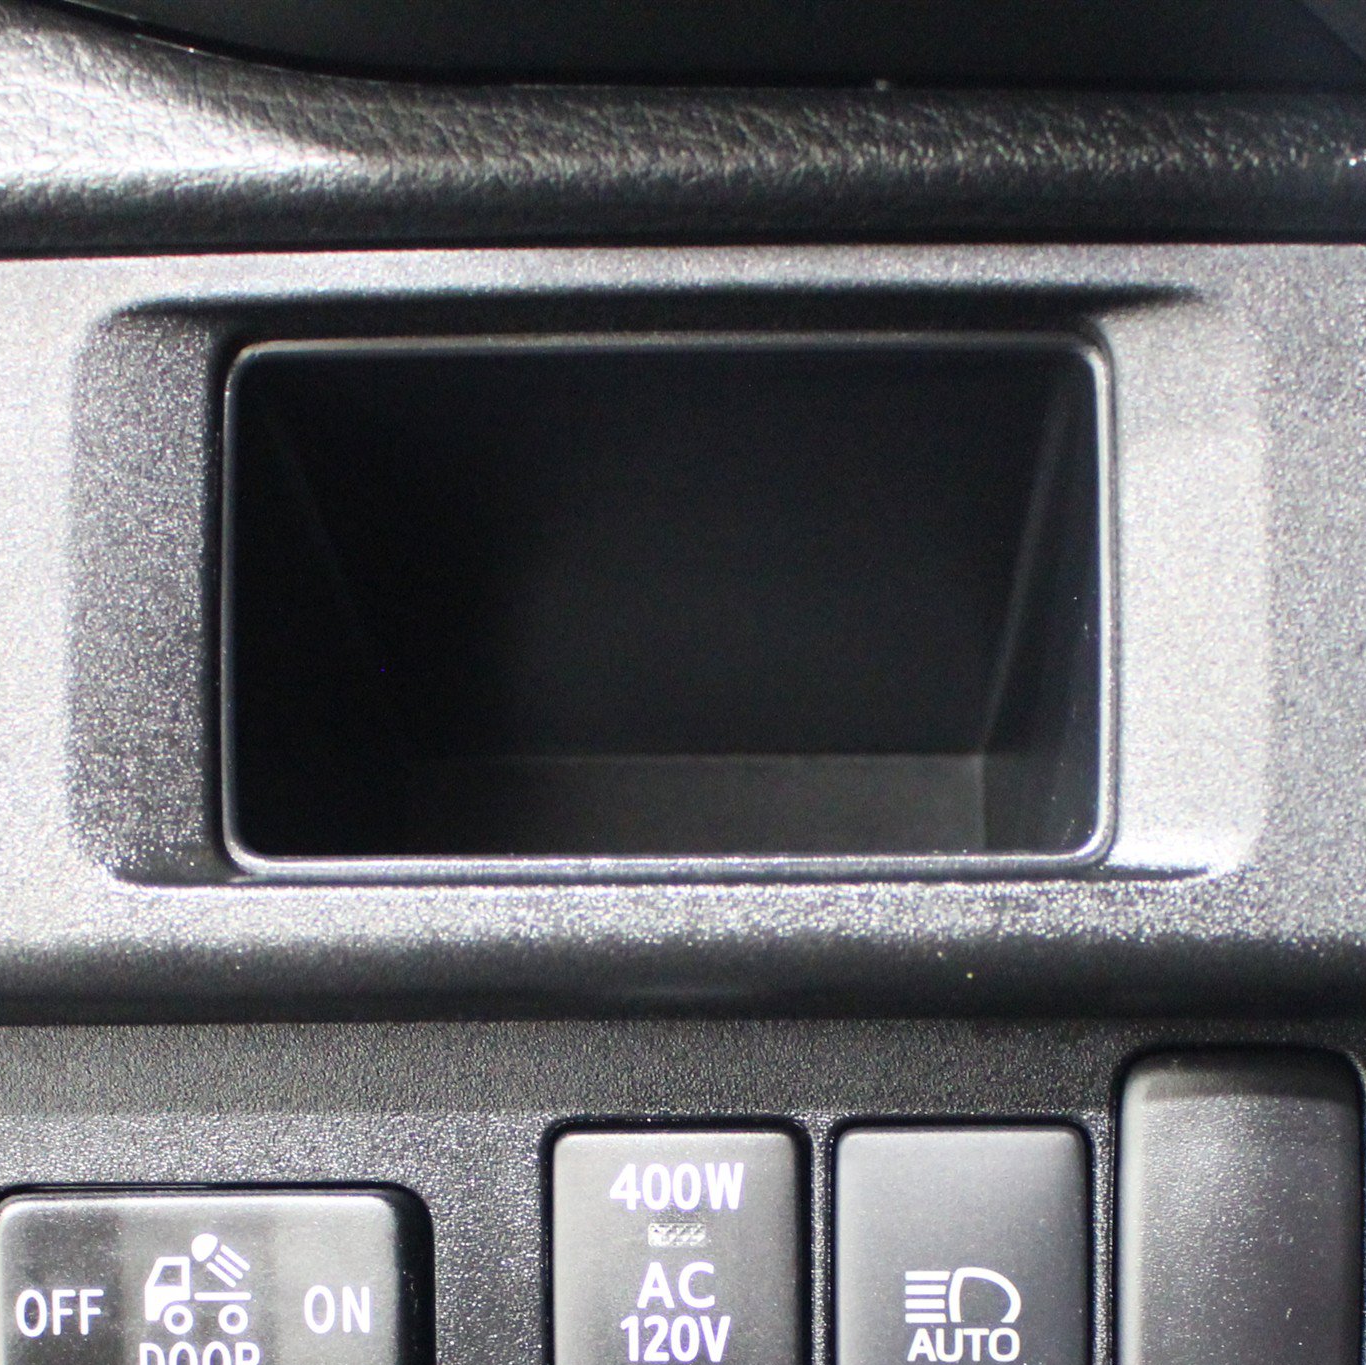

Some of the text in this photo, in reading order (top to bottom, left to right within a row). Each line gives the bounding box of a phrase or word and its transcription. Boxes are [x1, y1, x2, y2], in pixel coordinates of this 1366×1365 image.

[609, 1161, 745, 1211] 400W
[303, 1284, 371, 1335] ON
[636, 1261, 716, 1309] AC
[15, 1288, 104, 1337] OFF
[620, 1314, 731, 1363] 120V
[906, 1327, 1021, 1363] AUTO
